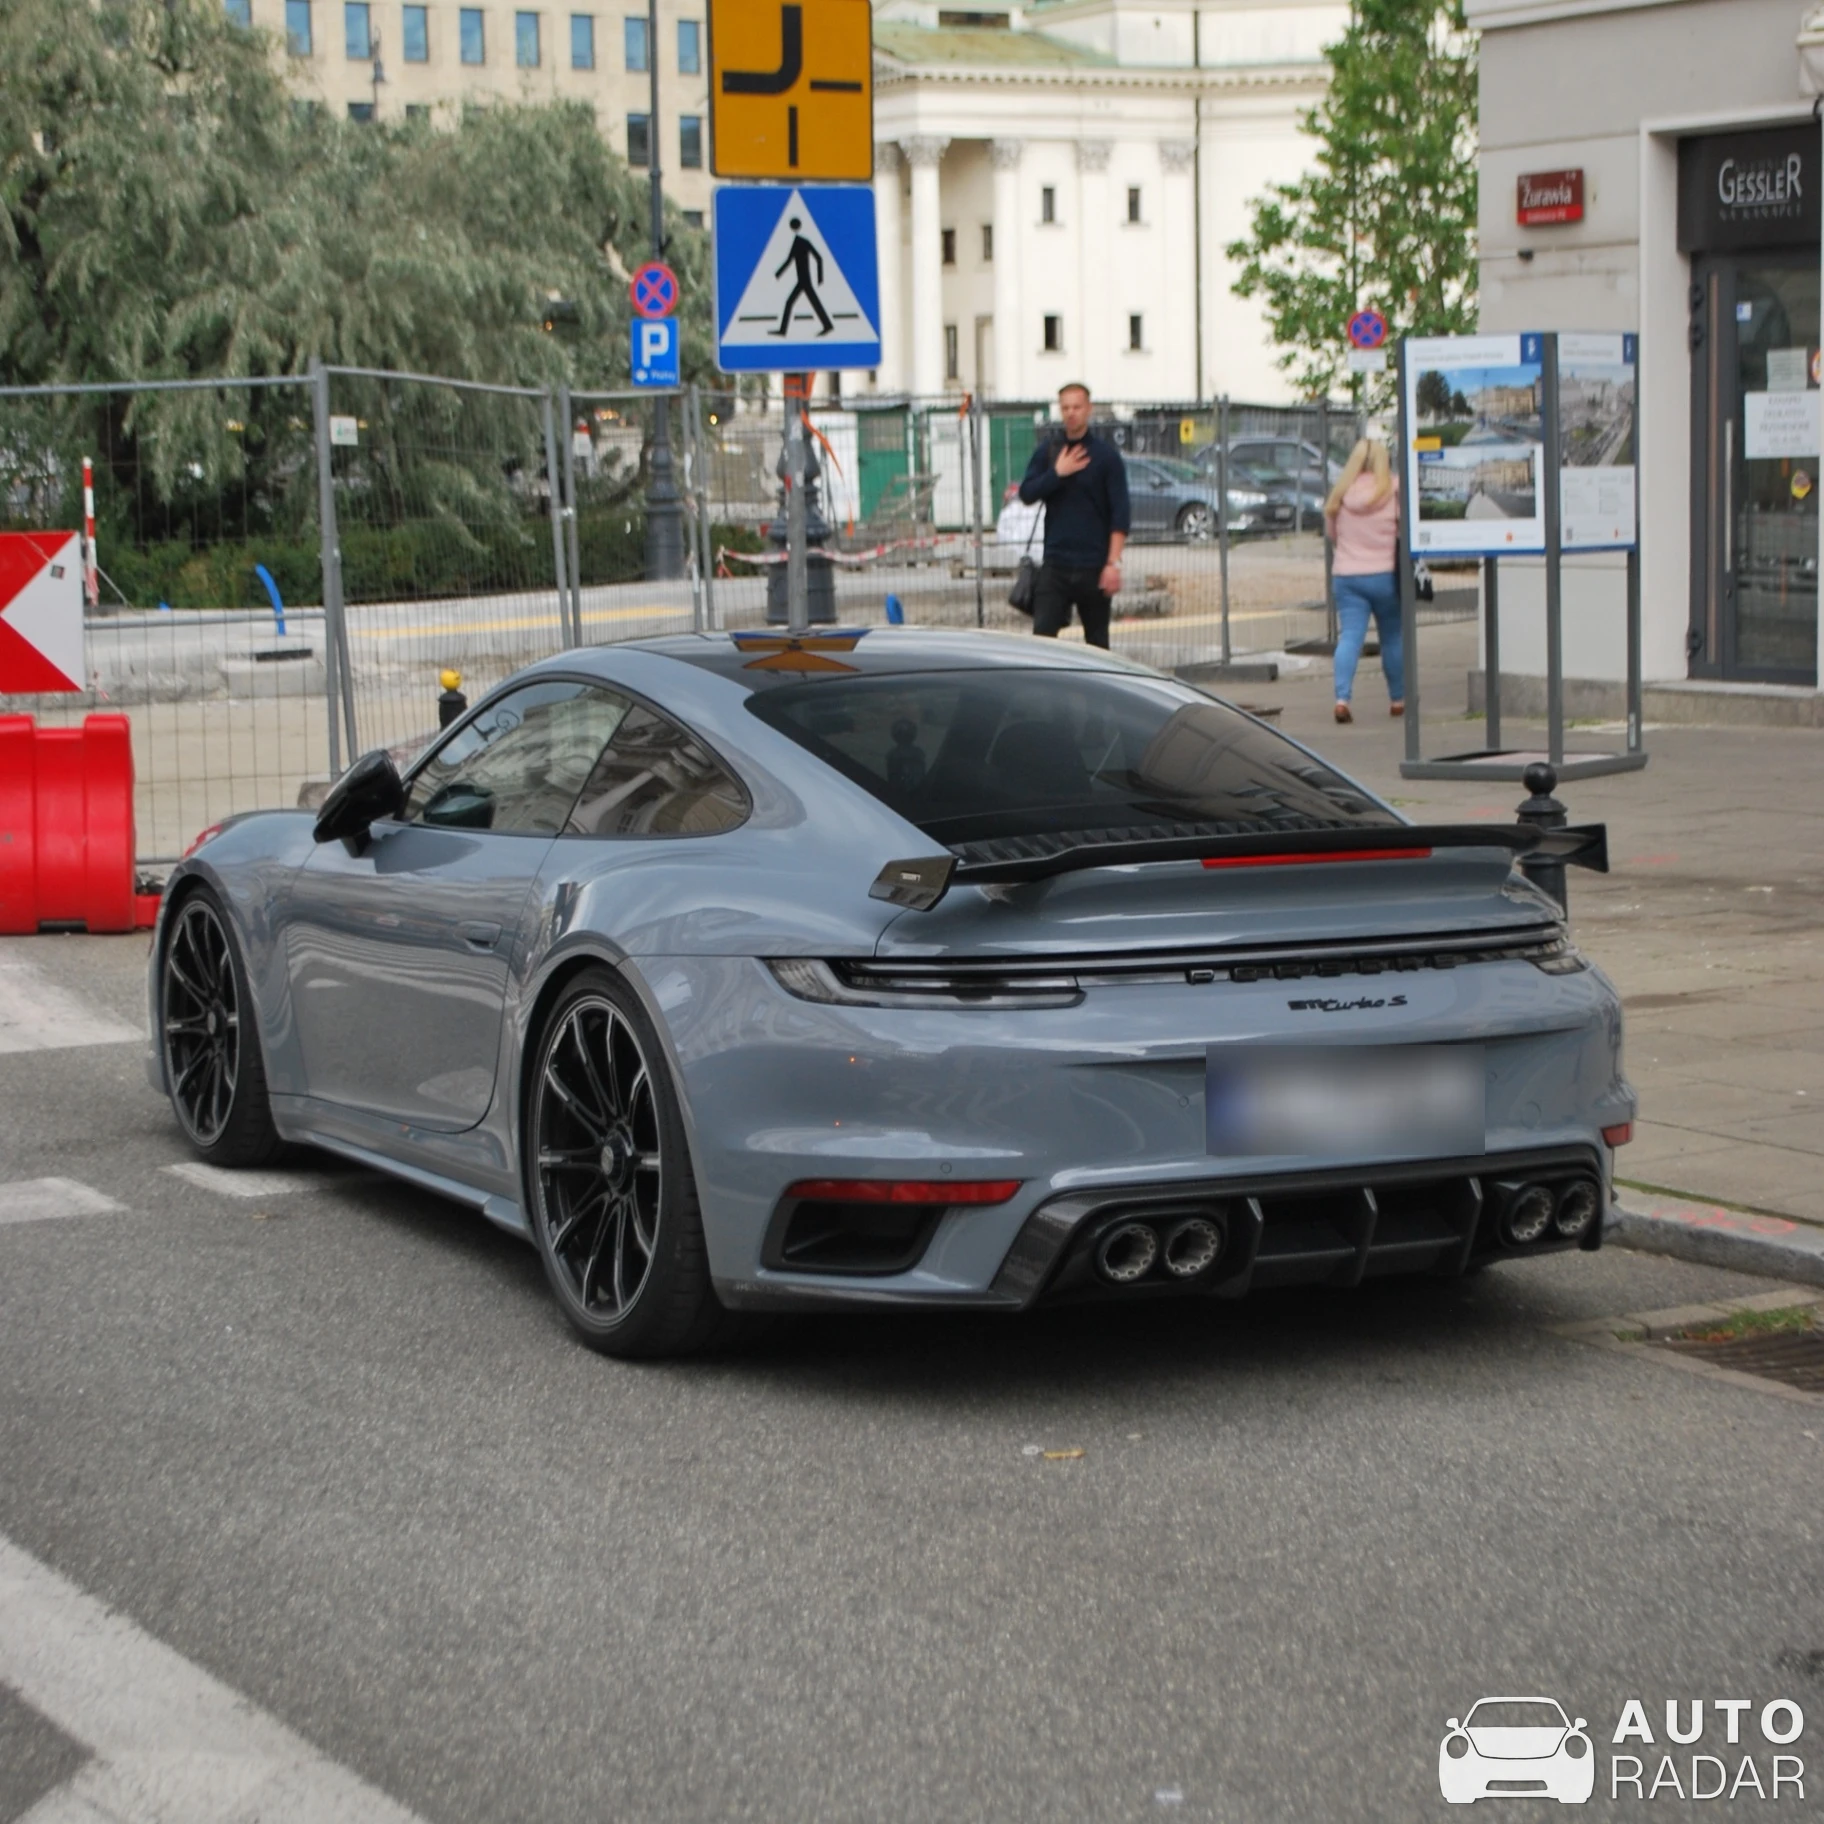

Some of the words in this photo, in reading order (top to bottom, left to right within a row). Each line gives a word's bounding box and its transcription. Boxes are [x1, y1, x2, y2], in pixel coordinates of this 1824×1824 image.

[1523, 179, 1572, 208] Żurawia
[641, 323, 669, 368] P
[1388, 995, 1408, 1007] S
